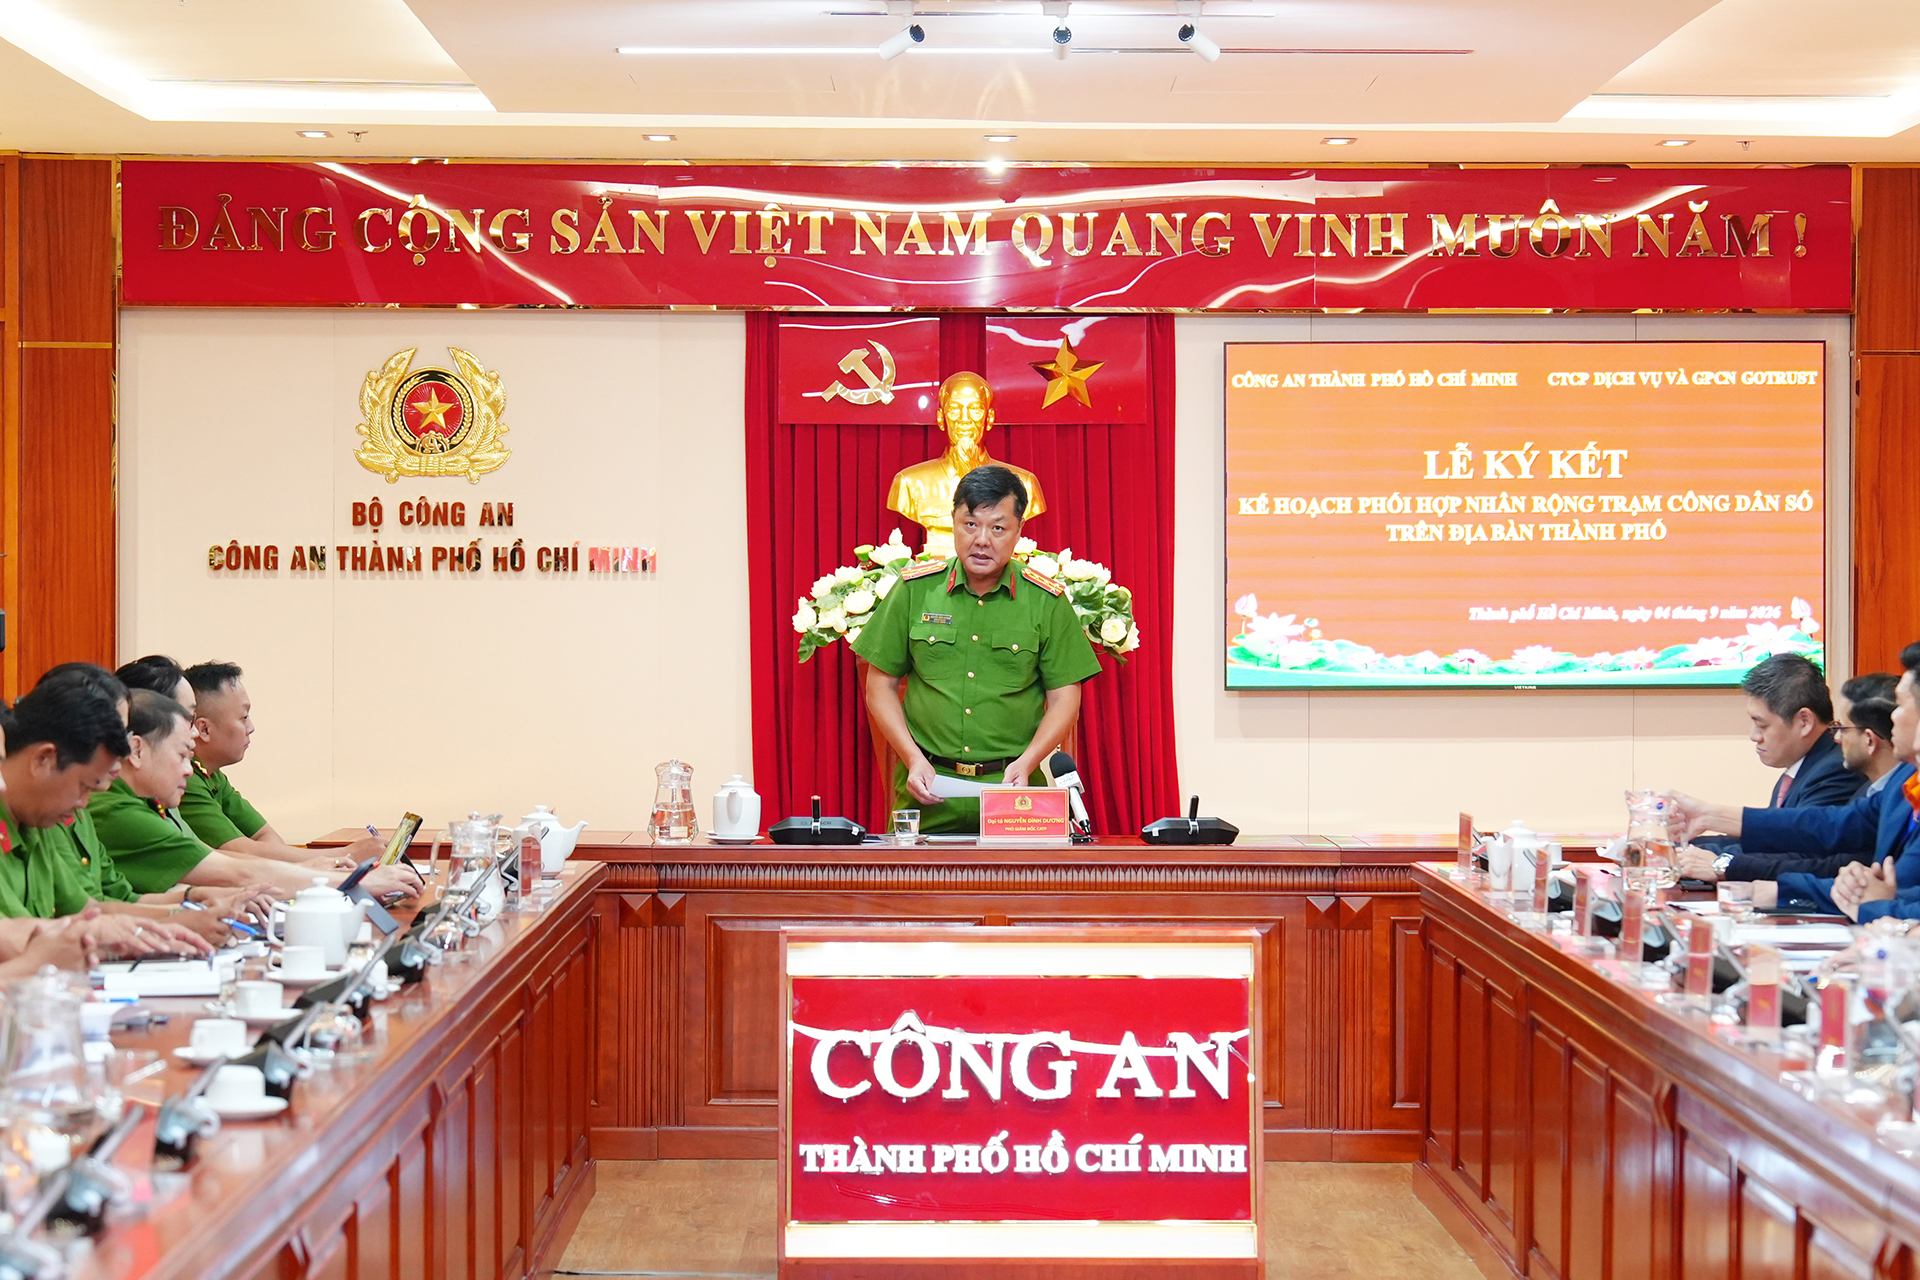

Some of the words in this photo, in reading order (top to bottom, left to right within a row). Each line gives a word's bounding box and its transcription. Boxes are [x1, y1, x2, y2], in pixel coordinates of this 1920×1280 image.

[158, 194, 336, 252] ĐẢNG
[354, 194, 532, 266] CỘNG
[551, 196, 669, 254] SẢN
[685, 203, 833, 268] VIỆT
[850, 211, 992, 256] NAM
[1011, 211, 1235, 267] QUANG
[1250, 213, 1409, 257] VINH
[1427, 198, 1616, 258] MUÔN
[1633, 200, 1774, 257] NĂM
[1794, 213, 1807, 258] !
[1231, 371, 1279, 388] CÔNG
[1282, 373, 1306, 388] AN
[1308, 370, 1366, 387] THÀNH
[1437, 369, 1467, 387] CHÍ
[1471, 373, 1518, 387] MINH
[1547, 372, 1589, 386] CTCP
[1593, 372, 1636, 389] DỊCH
[1638, 372, 1663, 389] VỤ
[1665, 368, 1689, 386] VÀ
[1692, 371, 1737, 386] GPCN
[1741, 371, 1818, 385] GOTRUST
[1423, 442, 1475, 480] LỄ
[1483, 442, 1540, 480] KÝ
[1548, 441, 1628, 479] KẾT
[352, 497, 383, 533] BỘ
[399, 496, 466, 527] CÔNG
[479, 502, 514, 527] AN
[1238, 493, 1270, 515] KẾ
[1273, 497, 1352, 518] HOẠCH
[1358, 492, 1412, 514] PHỐI
[1415, 496, 1462, 517] HỢP
[1465, 492, 1526, 514] NHÂN
[1531, 493, 1595, 517] RỘNG
[1599, 495, 1662, 516] TRẠM
[1667, 490, 1731, 513] CÔNG
[1735, 490, 1780, 512] DÂN
[1785, 490, 1814, 512] SỐ
[1386, 520, 1444, 542] TRÊN
[1448, 524, 1488, 545] ĐỊA
[1490, 520, 1534, 542] BÀN
[1539, 519, 1616, 541] THÀNH
[1620, 519, 1667, 541] PHỐ
[208, 540, 279, 572] CÔNG
[290, 546, 326, 572] AN
[336, 540, 422, 572] THÀNH
[432, 538, 482, 572] PHỐ
[493, 538, 526, 572] HỒ
[537, 541, 581, 572] CHÍ
[588, 546, 657, 573] MINH
[1468, 607, 1509, 621] Thành
[1654, 606, 1671, 619] 04
[1709, 605, 1719, 619] 9
[1749, 605, 1782, 619] 2026
[810, 1009, 1078, 1101] CÔNG
[1096, 1030, 1235, 1100] AN
[799, 1136, 926, 1174] THÀNH
[932, 1130, 1010, 1174] PHỐ
[1013, 1129, 1070, 1174] HỒ
[1075, 1132, 1144, 1173] CHÍ
[1148, 1144, 1248, 1173] MINH
